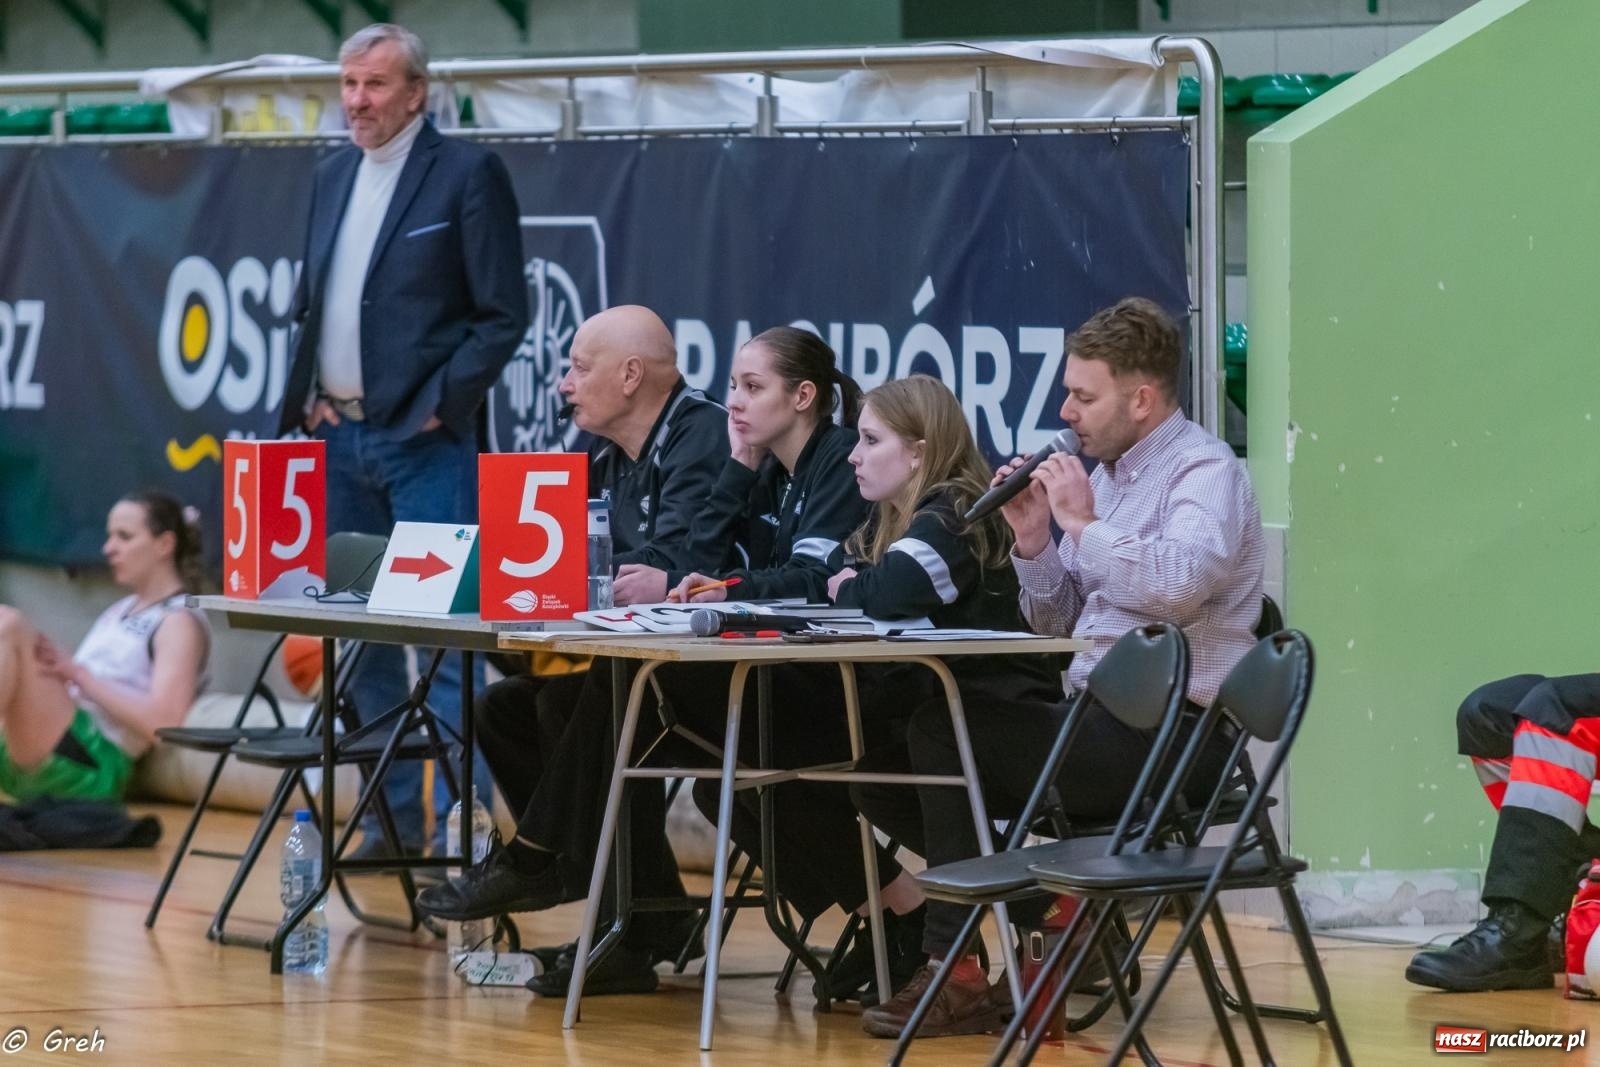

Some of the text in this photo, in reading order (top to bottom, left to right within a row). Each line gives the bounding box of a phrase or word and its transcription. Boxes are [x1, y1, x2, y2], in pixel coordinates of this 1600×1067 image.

[157, 255, 304, 414] OSi
[228, 458, 249, 559] 5
[270, 458, 316, 560] 5
[499, 471, 570, 578] 5
